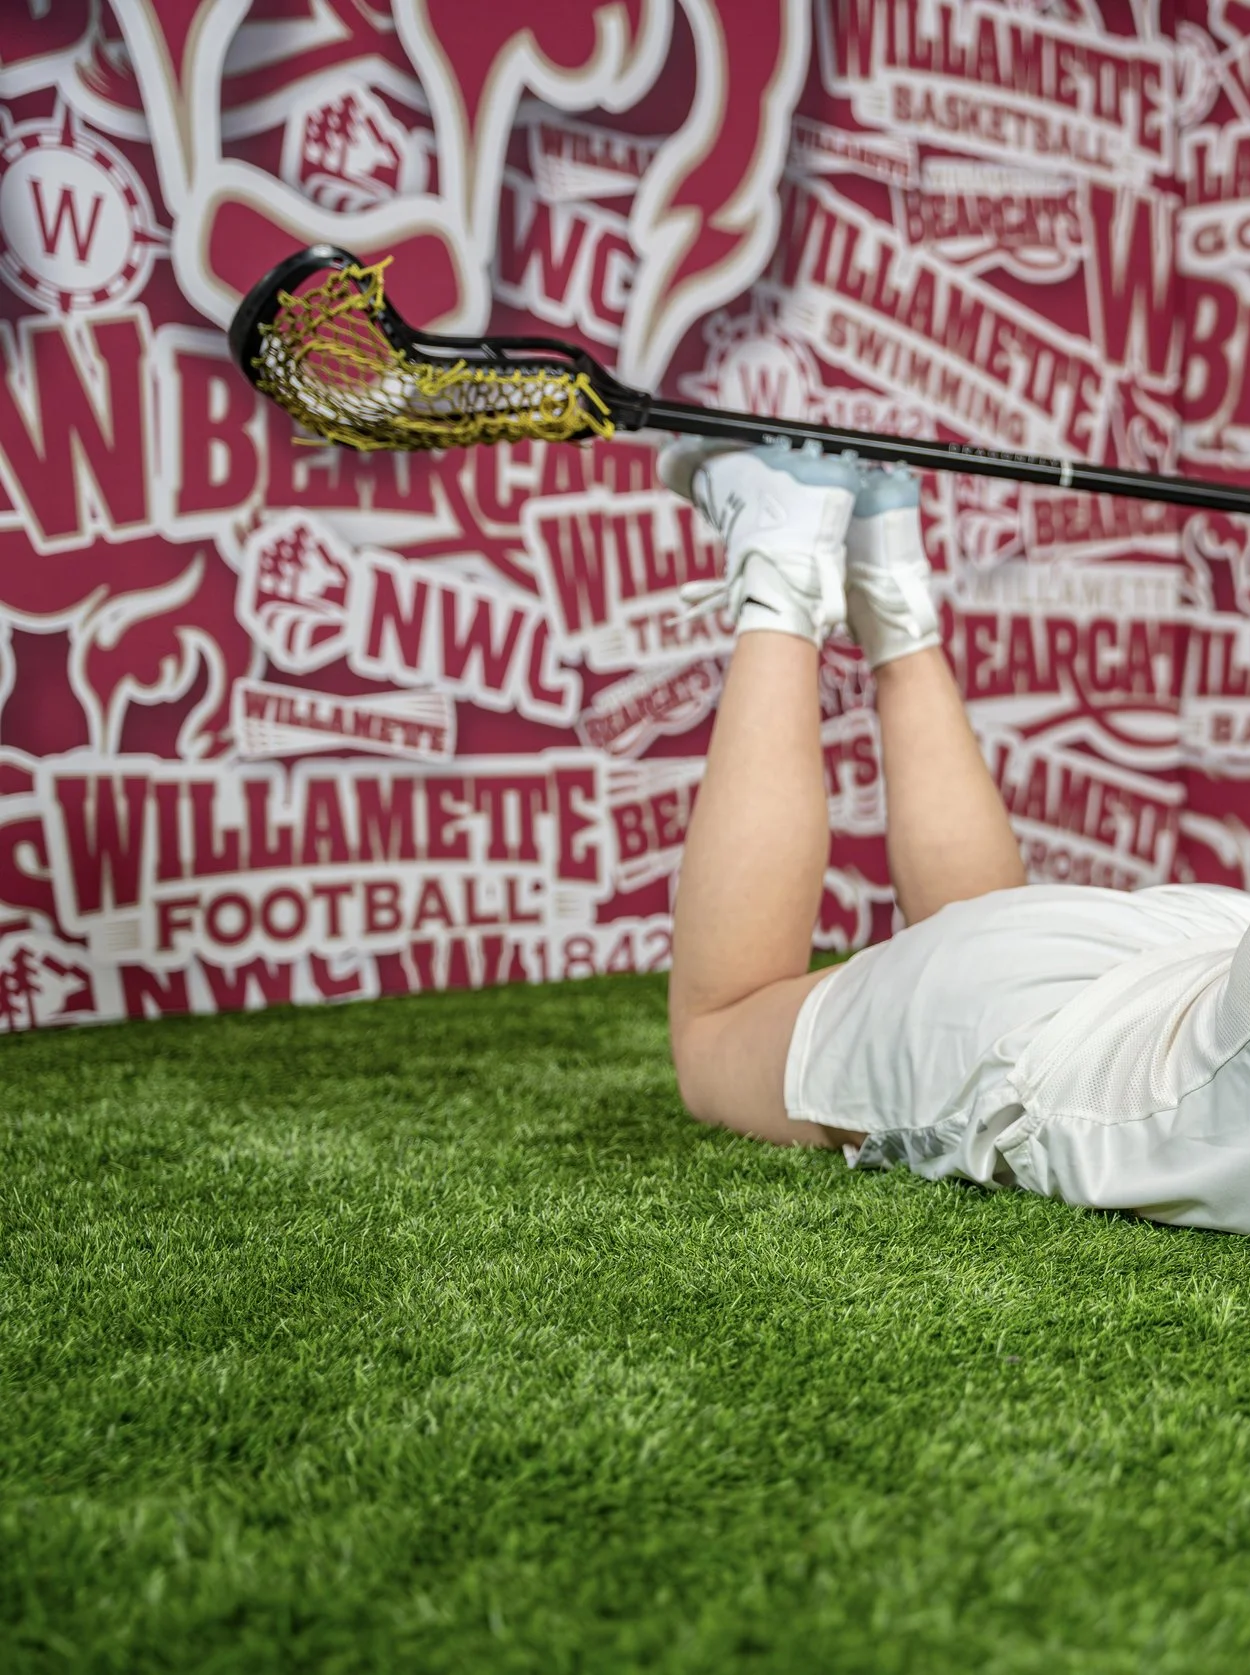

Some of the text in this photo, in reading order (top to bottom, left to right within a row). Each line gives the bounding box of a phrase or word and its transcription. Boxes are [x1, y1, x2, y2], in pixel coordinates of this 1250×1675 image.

[893, 85, 1116, 174] BASKETBALL
[28, 176, 104, 264] W
[825, 312, 1027, 447] SWIMMING
[244, 689, 448, 753] WILLAMETTE
[56, 768, 600, 916] WILLAMETTE
[612, 785, 697, 861] BE
[157, 876, 544, 951] FOOTBALL
